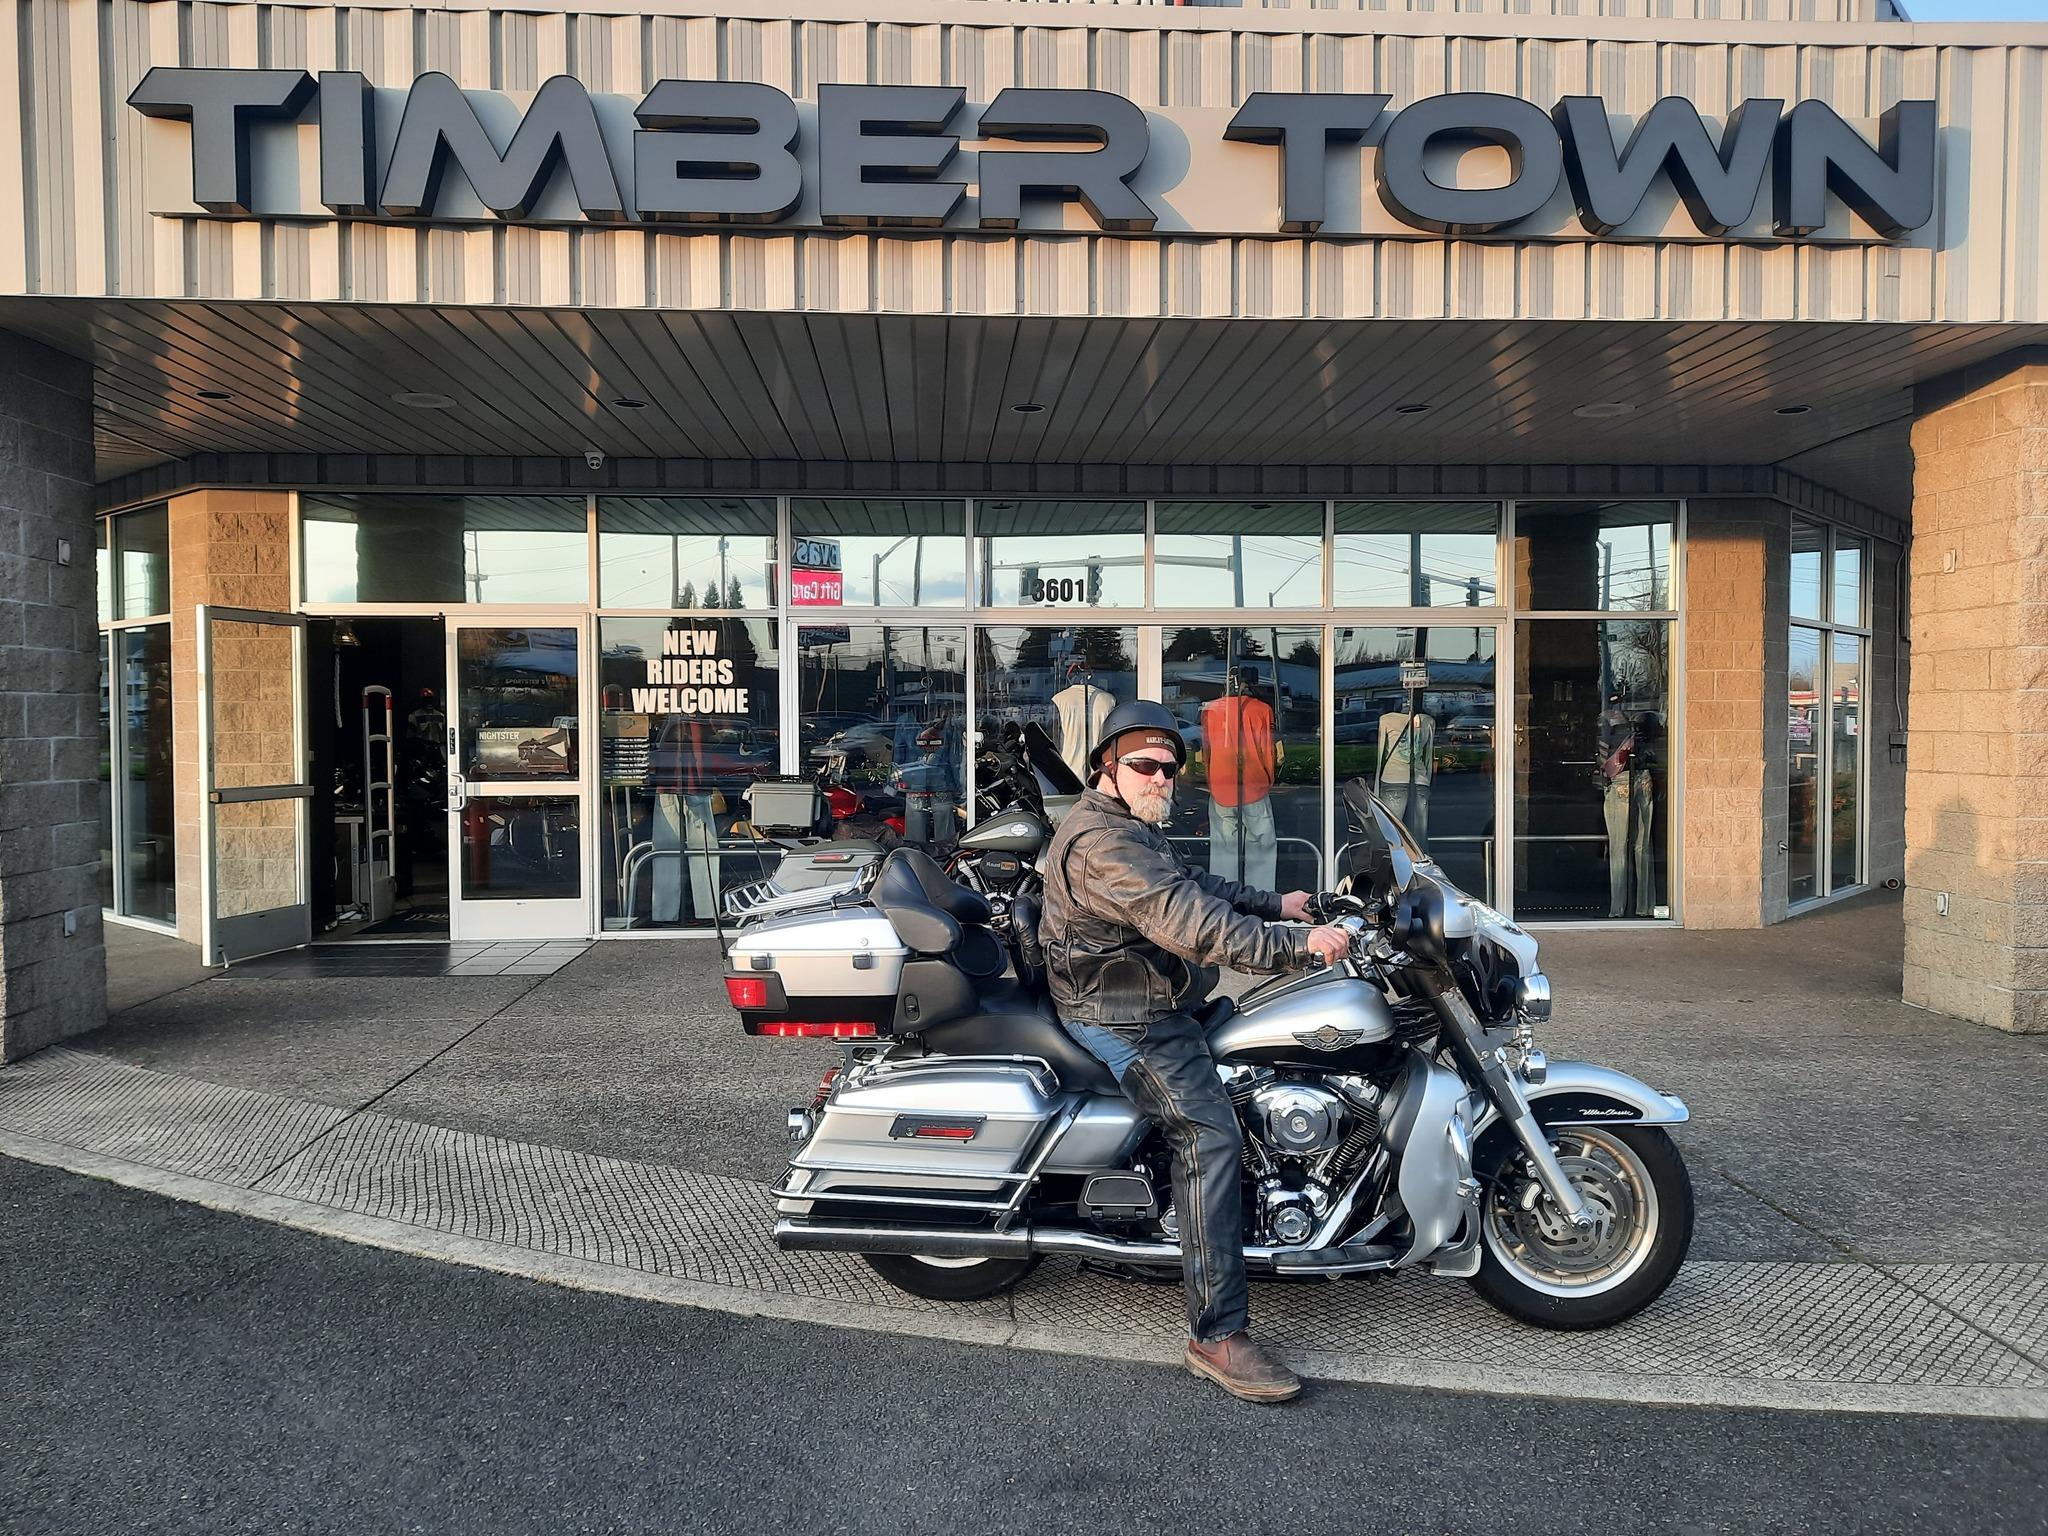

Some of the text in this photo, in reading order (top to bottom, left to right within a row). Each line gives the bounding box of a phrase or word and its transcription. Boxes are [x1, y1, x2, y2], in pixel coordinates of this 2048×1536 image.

[128, 67, 1935, 238] TIMBER TOWN
[1031, 578, 1084, 602] 3601
[663, 630, 717, 655] NEW
[647, 659, 734, 685] RIDERS
[631, 687, 749, 713] WELCOME
[479, 731, 520, 740] NIGHTSTER
